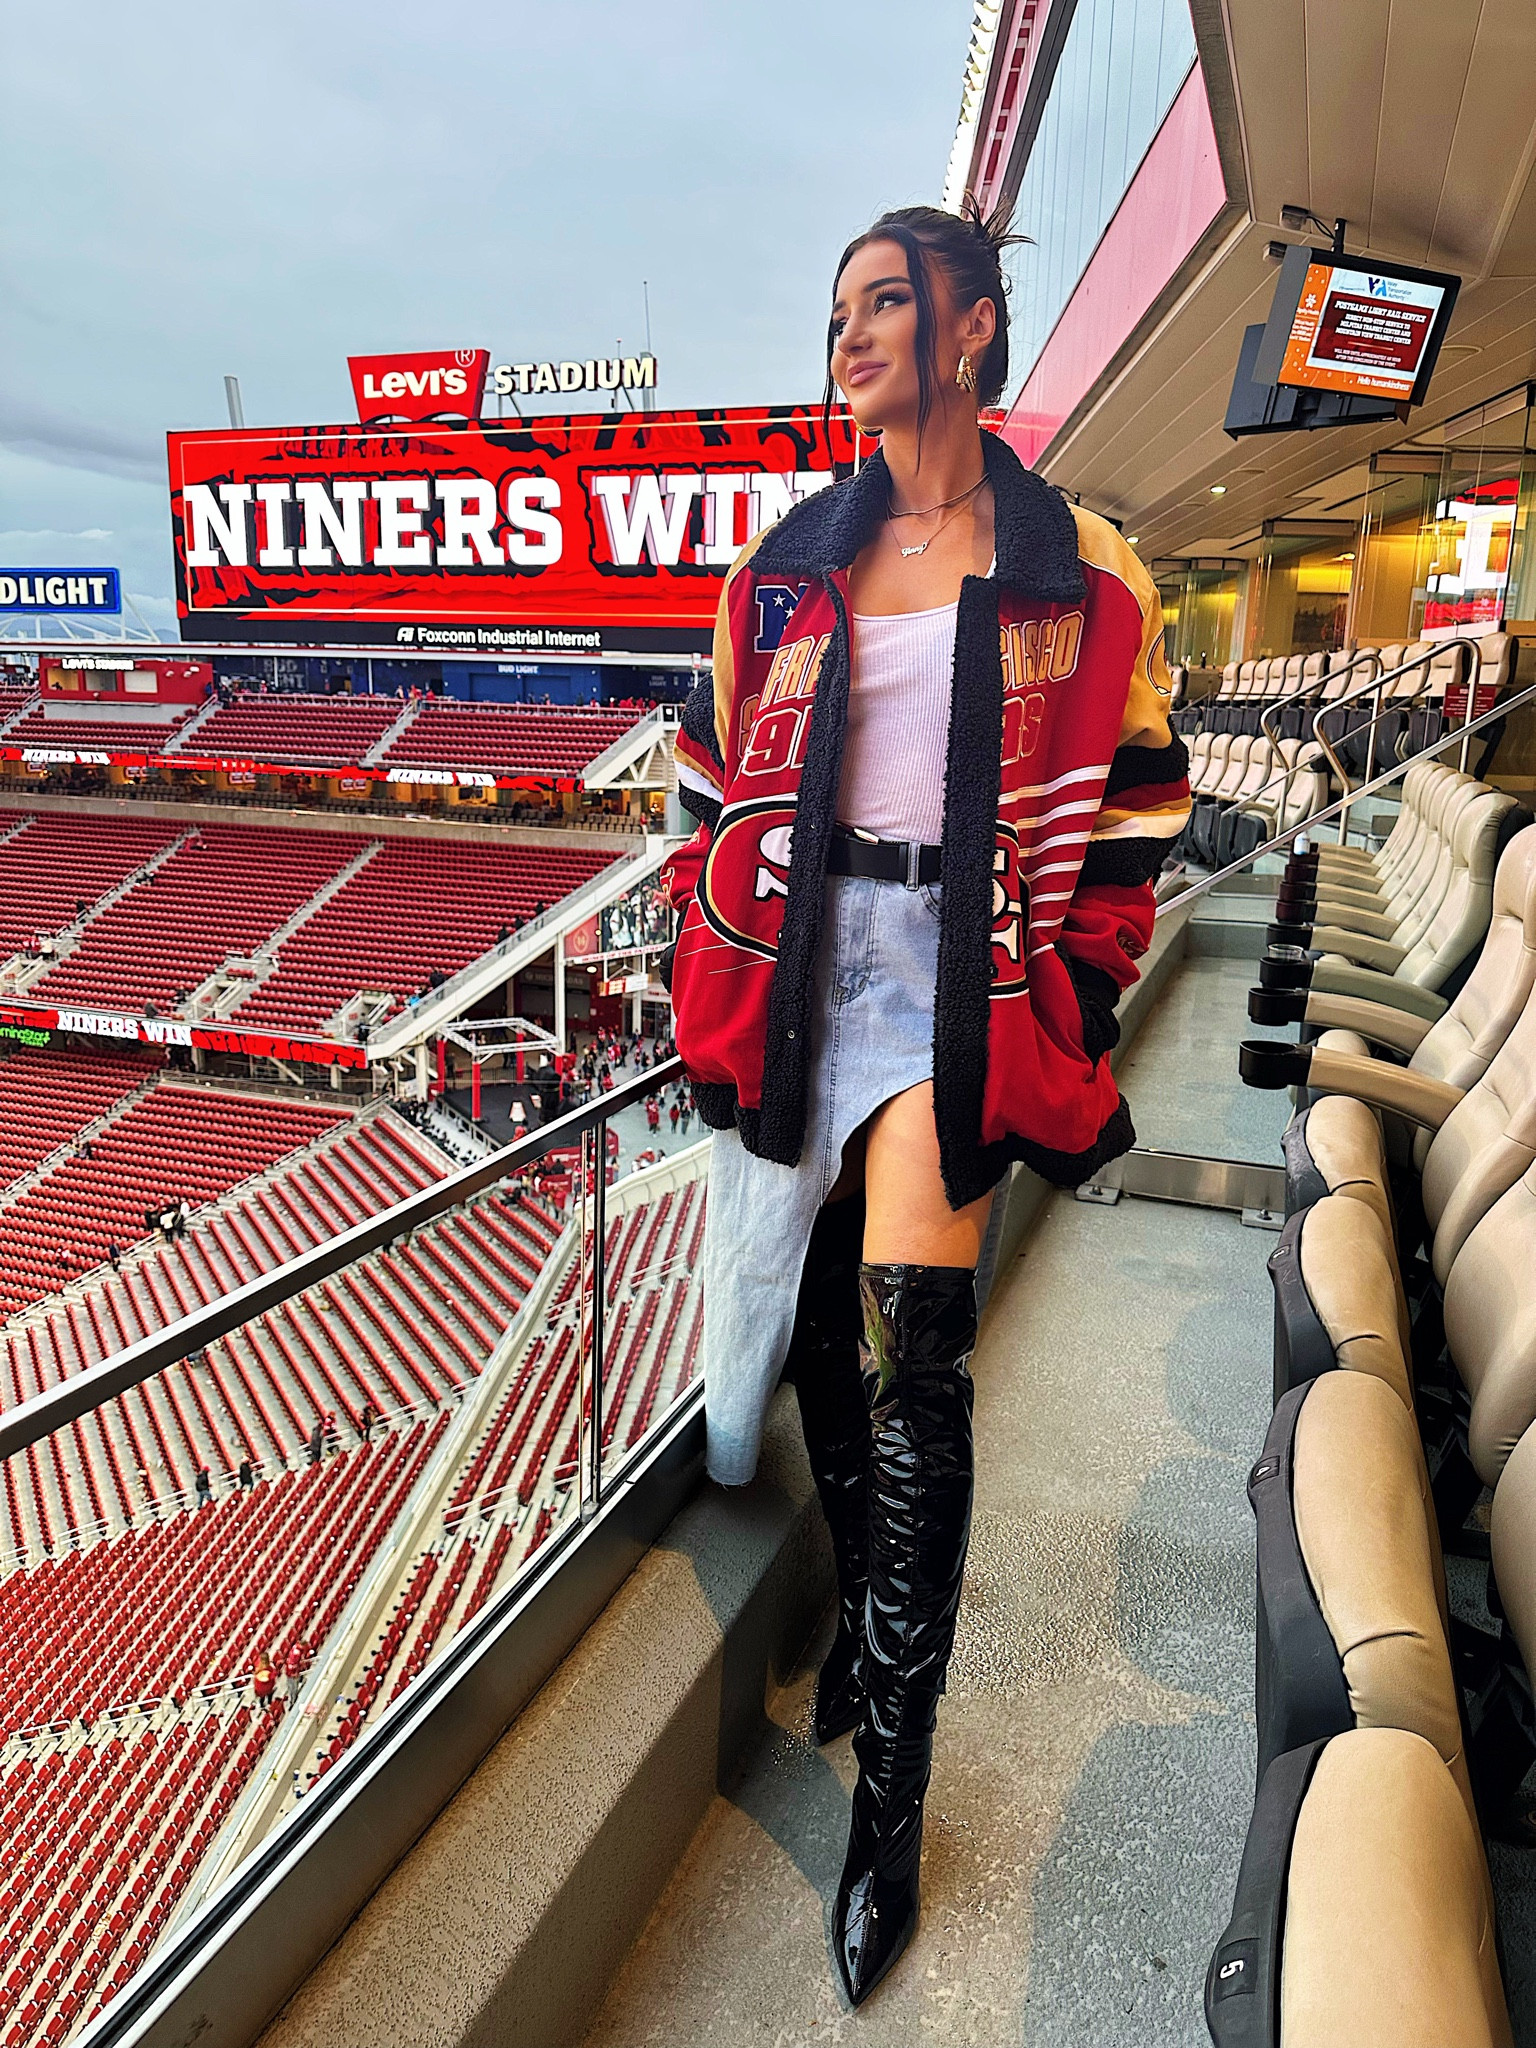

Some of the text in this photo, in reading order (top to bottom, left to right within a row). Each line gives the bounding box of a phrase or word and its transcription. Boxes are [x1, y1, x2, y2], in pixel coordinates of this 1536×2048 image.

[1401, 312, 1427, 323] SERVICE
[493, 357, 656, 395] STADIUM
[183, 476, 563, 568] NINERS
[418, 627, 476, 644] Foxconn
[477, 628, 542, 645] Industrial
[545, 630, 600, 647] Internet
[498, 664, 539, 674] BUD LIGHT
[22, 749, 110, 766] NINERS WIN
[387, 768, 497, 788] NINERS WIN
[57, 1010, 192, 1046] NINERS WIN
[1220, 1960, 1244, 1979] 5
